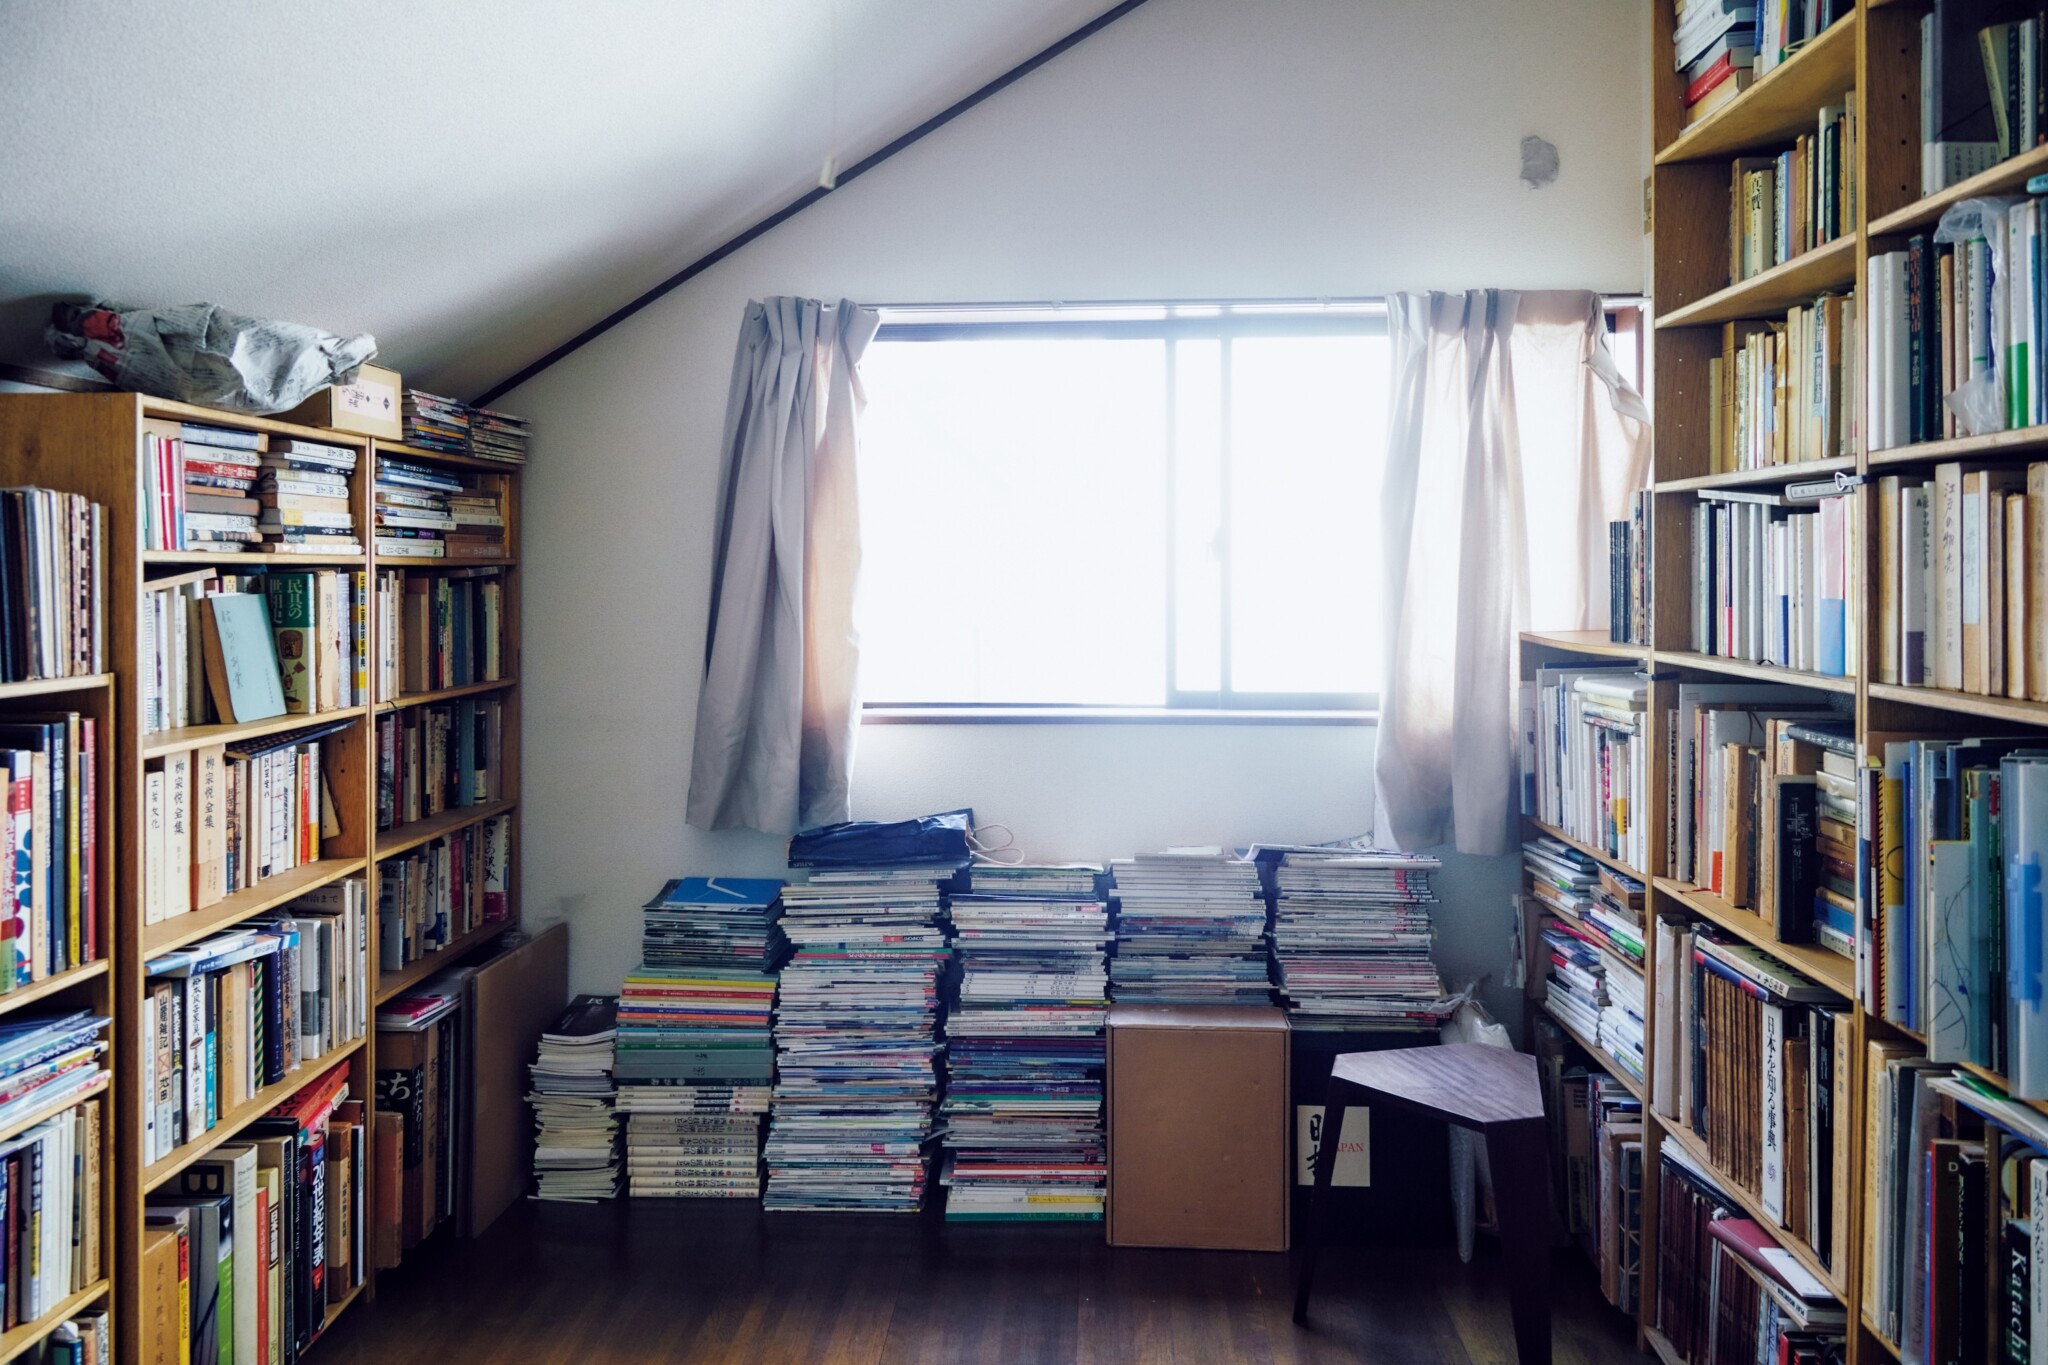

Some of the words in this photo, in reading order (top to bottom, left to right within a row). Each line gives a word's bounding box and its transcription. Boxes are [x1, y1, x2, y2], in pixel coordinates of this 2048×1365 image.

[287, 579, 302, 619] 民具の
[205, 755, 215, 829] 柳宗悦全集
[1767, 1014, 1777, 1153] 日本を知る事典
[2011, 1247, 2027, 1365] Karachi
